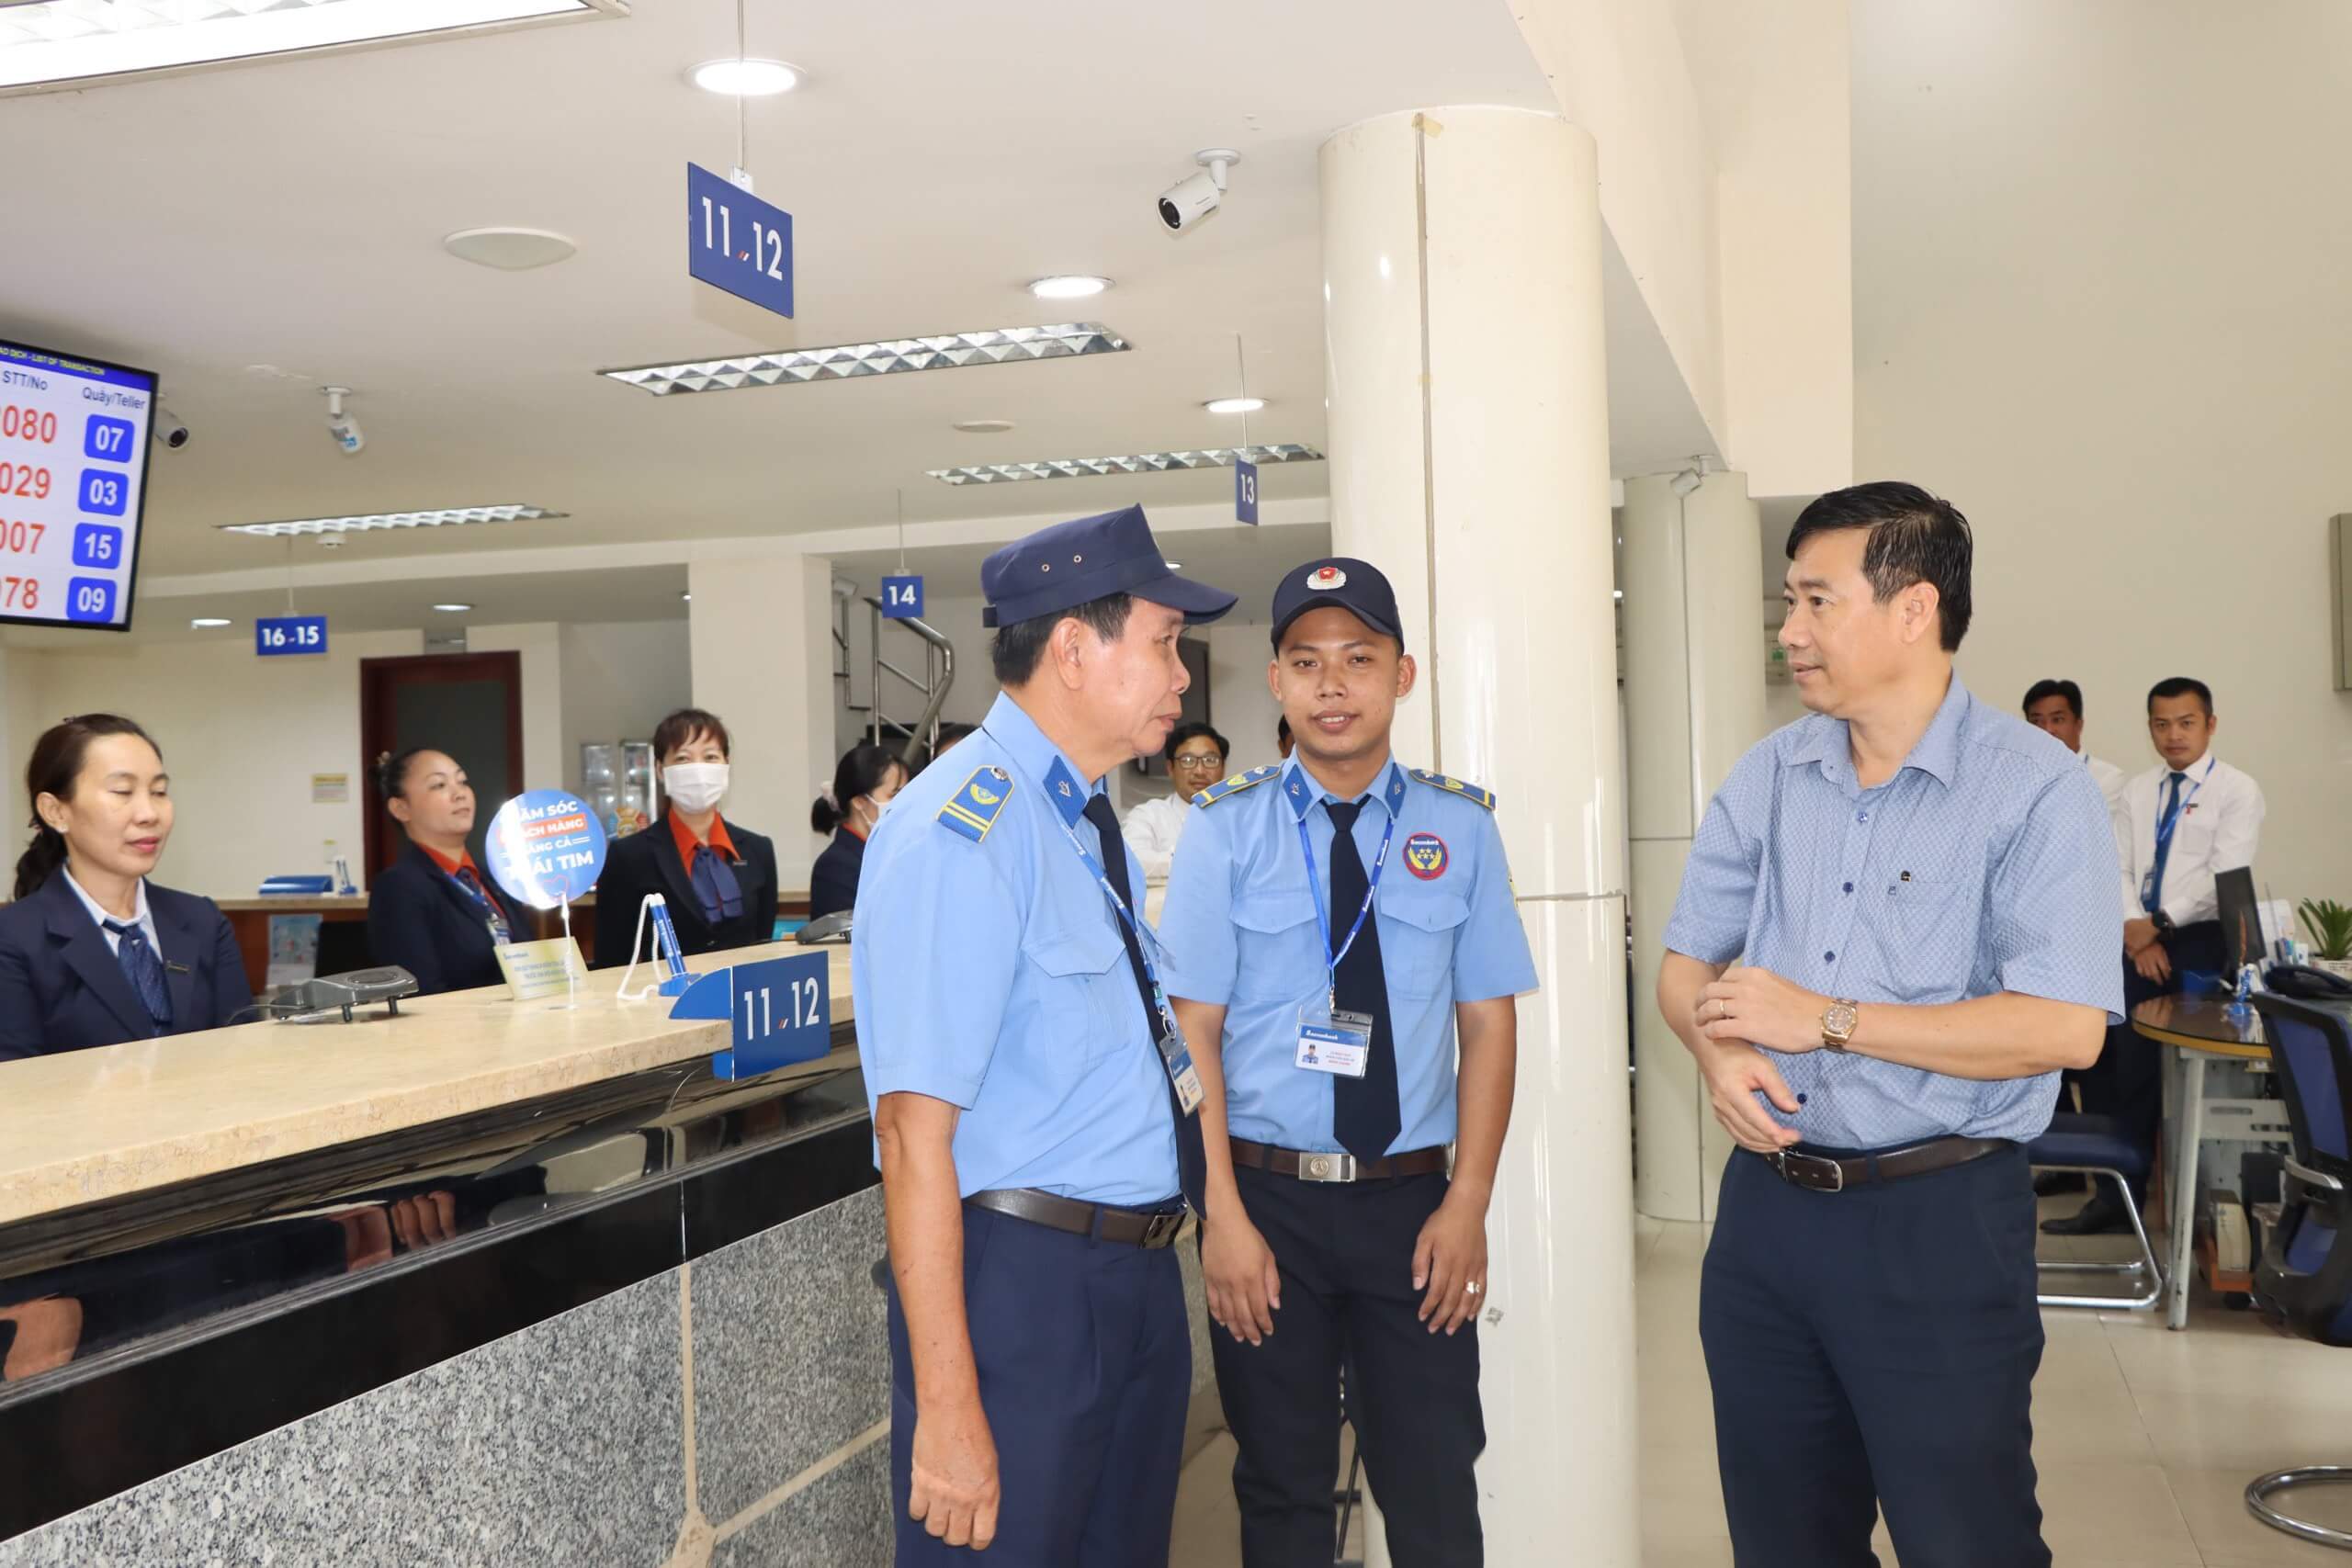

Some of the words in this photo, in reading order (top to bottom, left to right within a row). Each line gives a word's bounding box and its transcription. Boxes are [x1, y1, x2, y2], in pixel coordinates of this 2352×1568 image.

[702, 196, 730, 257] 11
[752, 220, 783, 281] 12
[3, 370, 48, 390] STT/No
[0, 405, 57, 444] 080
[95, 424, 125, 453] 07
[89, 479, 118, 505] 03
[1240, 473, 1255, 504] 13
[84, 532, 113, 559] 15
[0, 576, 40, 610] 78
[77, 586, 107, 614] 09
[888, 584, 916, 606] 14
[547, 800, 578, 817] SÓC
[557, 850, 594, 870] TIM
[744, 987, 771, 1041] 11
[791, 976, 820, 1029] 12
